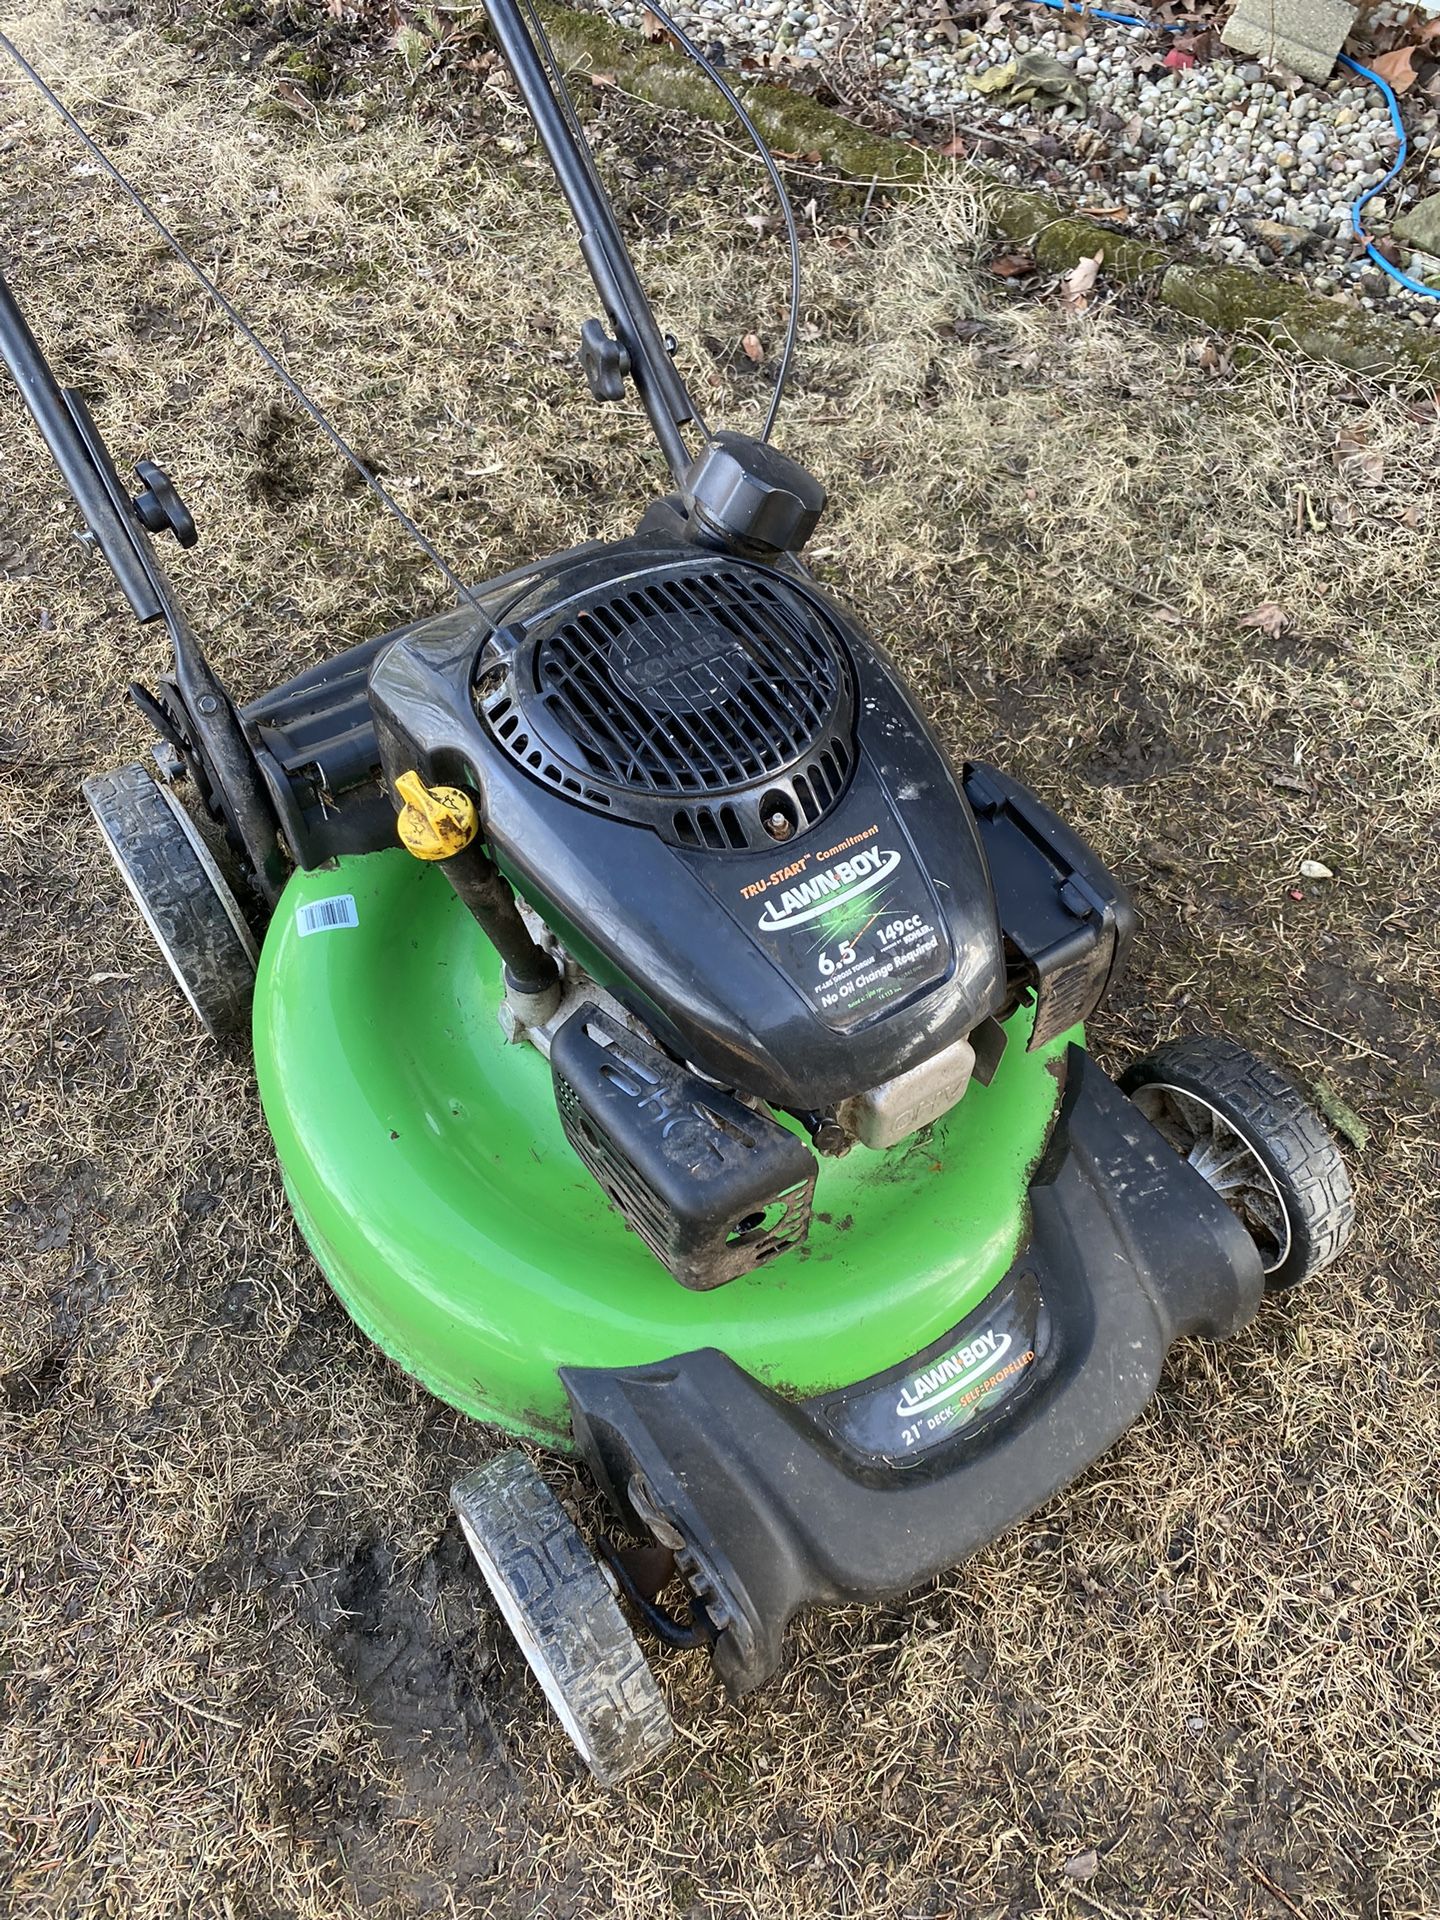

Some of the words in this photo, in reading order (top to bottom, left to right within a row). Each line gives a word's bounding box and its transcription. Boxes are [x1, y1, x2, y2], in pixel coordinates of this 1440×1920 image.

[815, 824, 879, 862] Commitment
[876, 914, 922, 945] 149cc
[818, 940, 857, 976] 6.5
[821, 993, 839, 1008] No
[839, 981, 855, 998] Oil
[855, 961, 894, 988] Change
[893, 935, 938, 968] Required
[832, 968, 852, 983] GROSS
[852, 956, 875, 973] TORQUE
[926, 1404, 955, 1430] DECK
[959, 1350, 1035, 1408] SELF-PROPELLED
